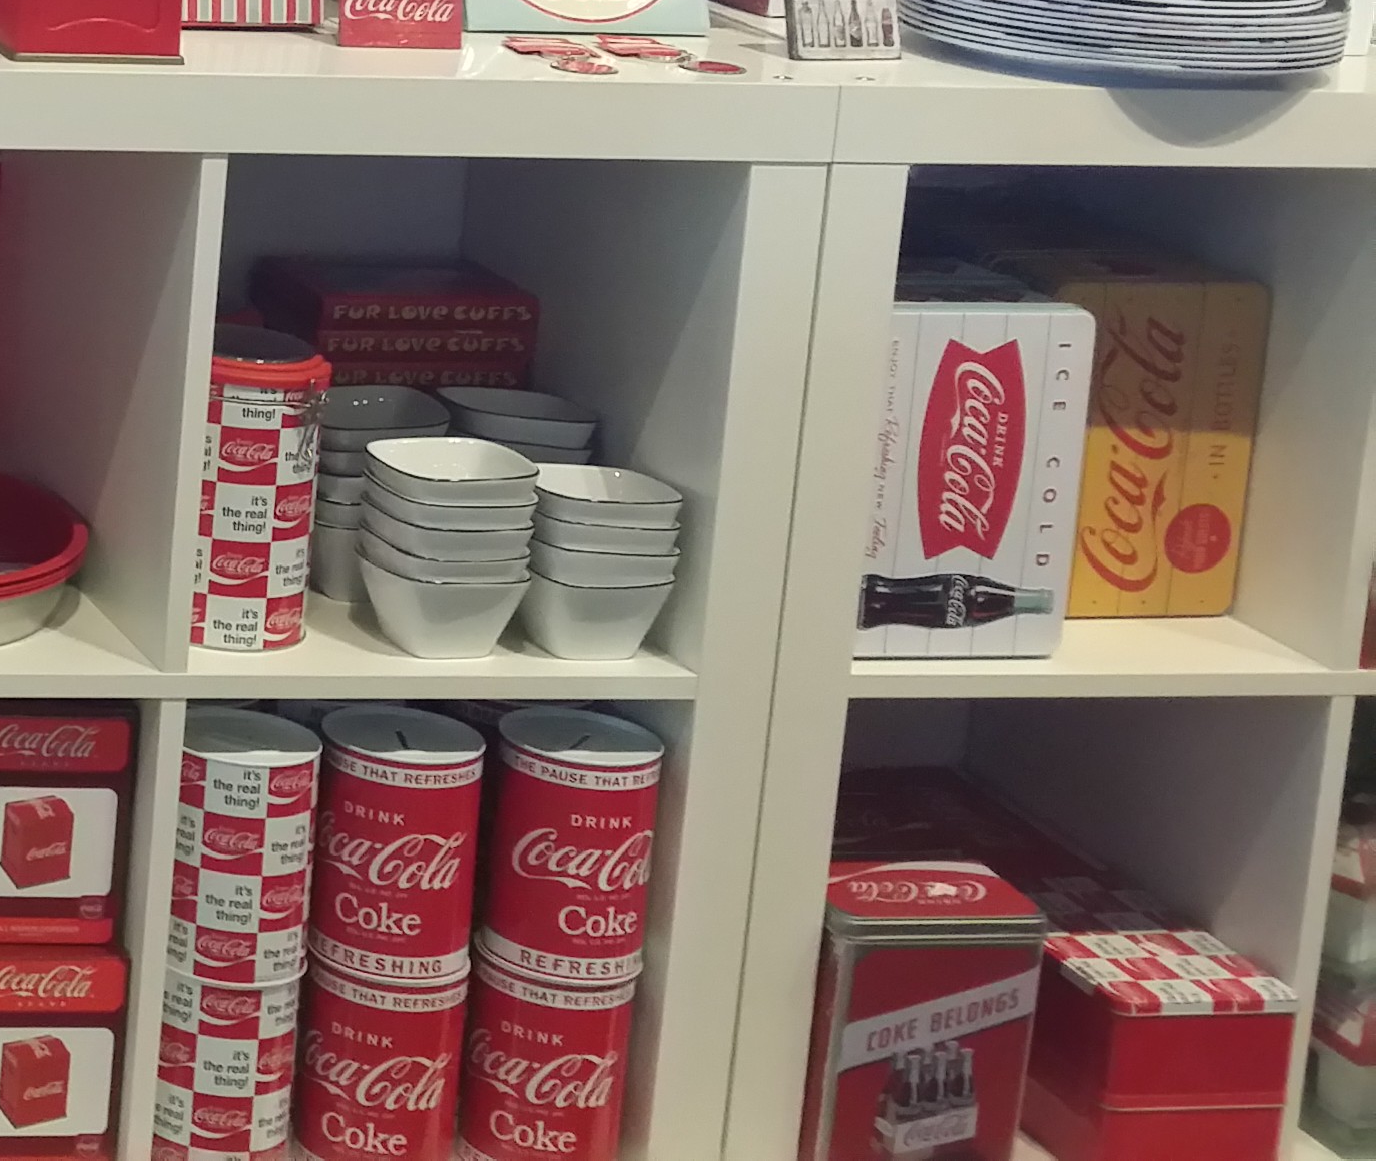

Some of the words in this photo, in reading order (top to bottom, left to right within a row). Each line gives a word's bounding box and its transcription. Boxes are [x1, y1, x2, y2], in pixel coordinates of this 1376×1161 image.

[1052, 342, 1072, 411] ICE
[242, 407, 276, 421] thing!
[221, 440, 274, 461] Coca-Cola
[938, 362, 1005, 541] Coca-Cola
[993, 412, 1009, 469] DRINK
[1081, 303, 1185, 592] Coca-Cola
[222, 507, 242, 518] the
[245, 508, 268, 519] real
[251, 495, 268, 506] it's
[1036, 457, 1060, 568] COLD
[232, 521, 266, 534] thing!
[212, 554, 265, 574] Coca-Cola
[946, 574, 968, 626] Coca-Cola
[243, 768, 261, 781] it's
[361, 765, 398, 783] THAT
[404, 768, 477, 785] REFRESHES
[515, 756, 536, 773] THE
[542, 765, 588, 785] PAUSE
[594, 771, 628, 787] THAT
[213, 780, 234, 792] the
[237, 783, 261, 794] real
[224, 795, 260, 808] thing!
[344, 801, 405, 827] DRINK
[570, 814, 632, 829] DRINK
[204, 828, 258, 849] Coca-Cola
[319, 810, 467, 890] Coca-Cola
[25, 843, 67, 862] Coca-Cola
[335, 892, 422, 936] Coke
[558, 905, 638, 938] Coke
[351, 989, 386, 1007] THAT
[522, 987, 557, 1005] THAT
[500, 1020, 564, 1046] DRINK
[866, 1021, 918, 1053] COKE
[930, 988, 1020, 1035] BELONGS
[331, 1021, 393, 1048] DRINK
[304, 1030, 451, 1111] Coca-Cola
[469, 1028, 618, 1109] Coca-Cola
[22, 1081, 65, 1101] Coca-Cola
[321, 1112, 407, 1155] Coke
[490, 1110, 577, 1153] Coke
